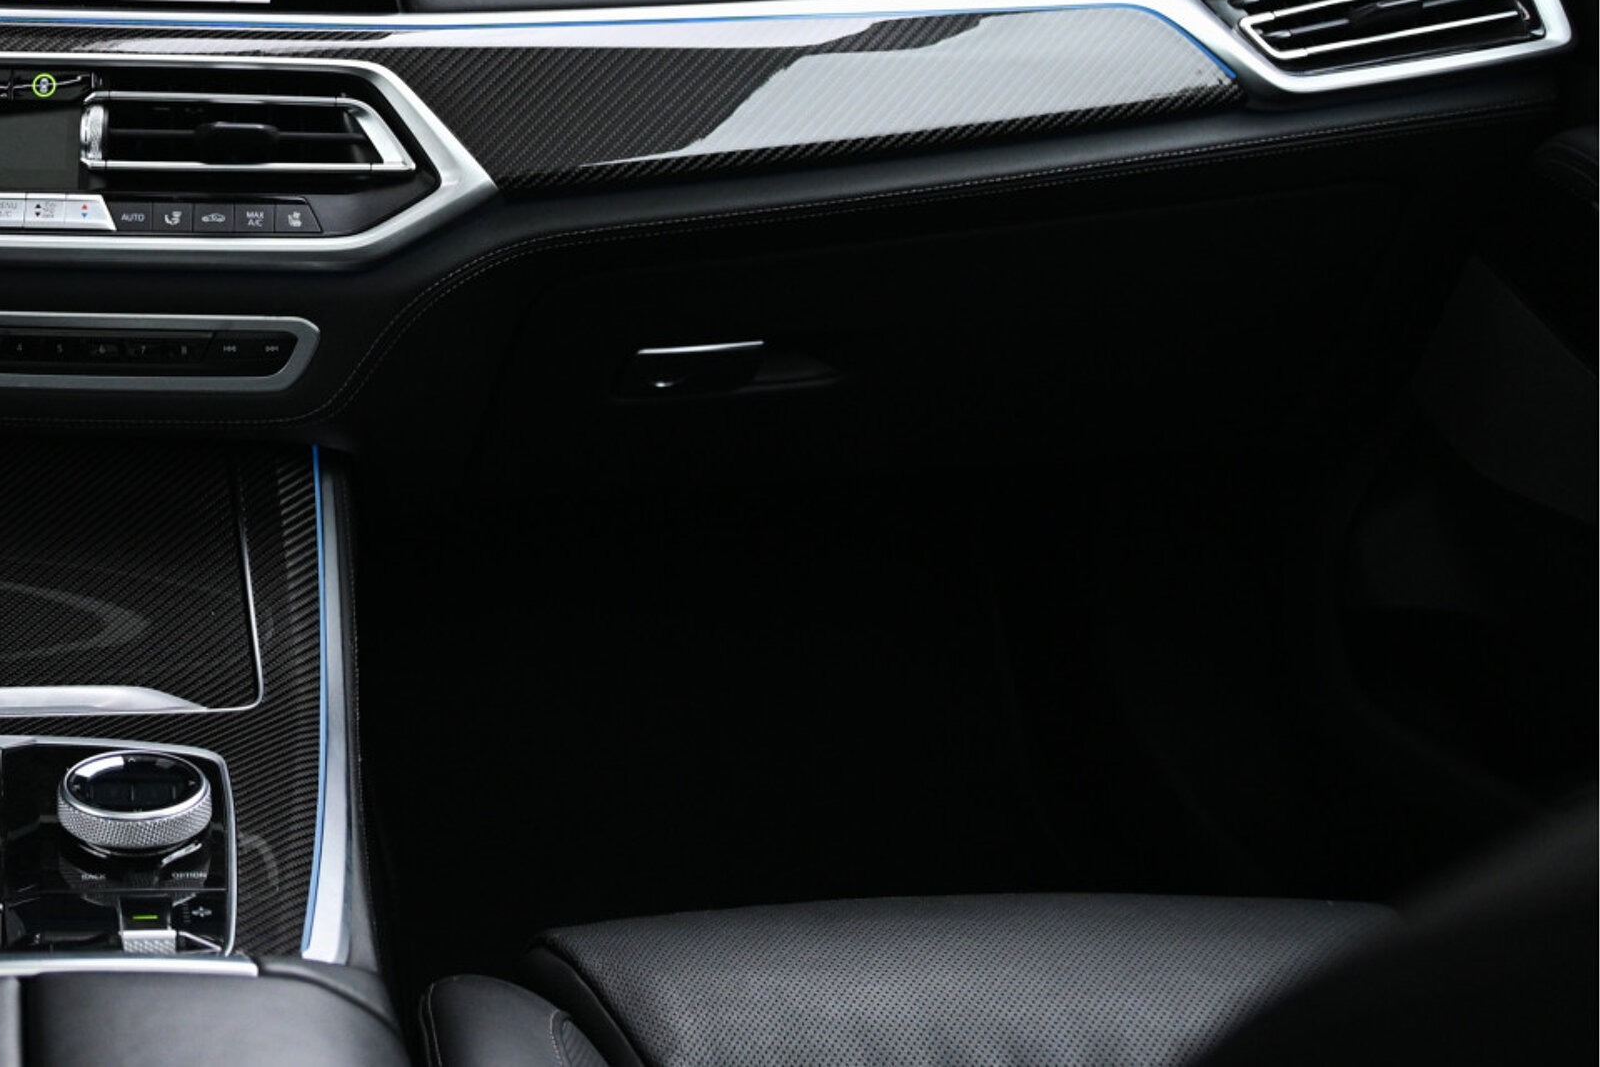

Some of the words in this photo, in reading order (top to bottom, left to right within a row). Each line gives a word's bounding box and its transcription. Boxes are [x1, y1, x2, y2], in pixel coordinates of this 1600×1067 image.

[121, 212, 145, 223] AUTO
[246, 210, 265, 219] MAX
[171, 871, 207, 879] OPTION
